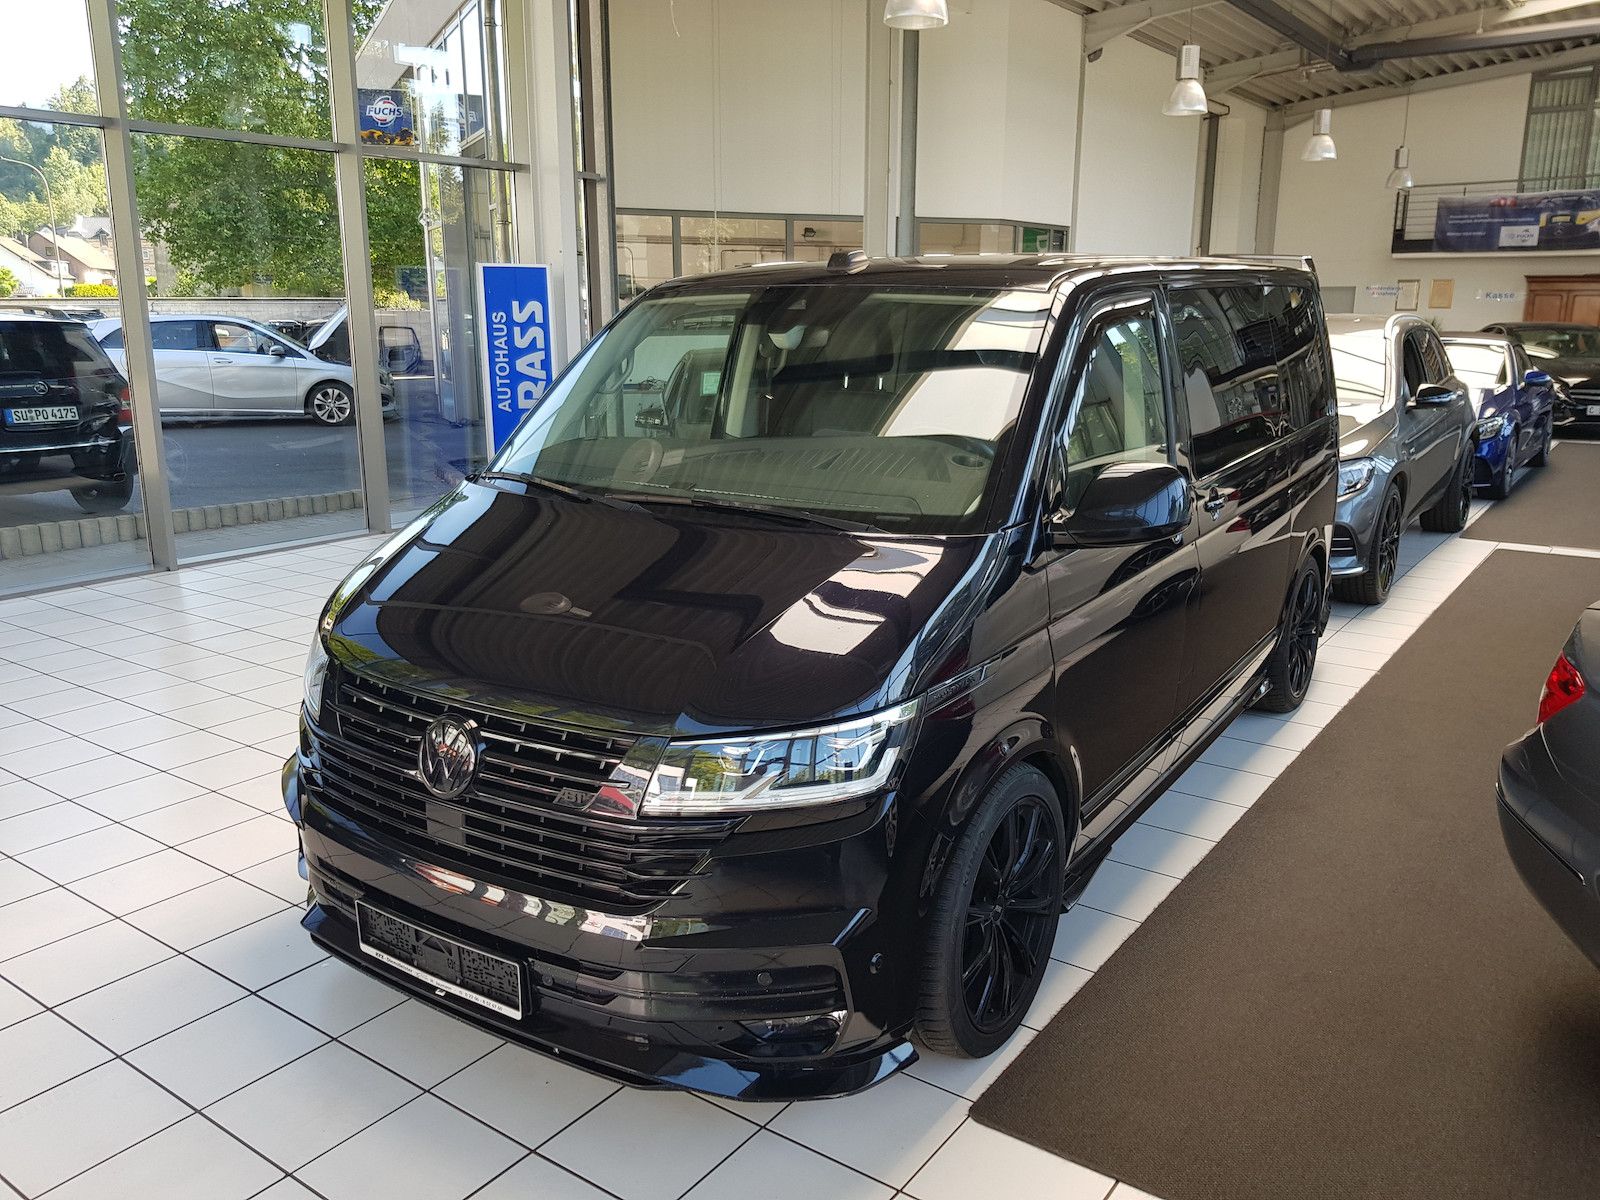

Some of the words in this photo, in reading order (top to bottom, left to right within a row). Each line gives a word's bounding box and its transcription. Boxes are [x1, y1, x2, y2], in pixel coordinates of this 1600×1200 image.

[366, 105, 403, 117] FUCHS
[491, 312, 513, 413] AUTOHAUS
[511, 300, 547, 422] RASS
[13, 409, 28, 422] SU
[51, 407, 77, 419] 4175
